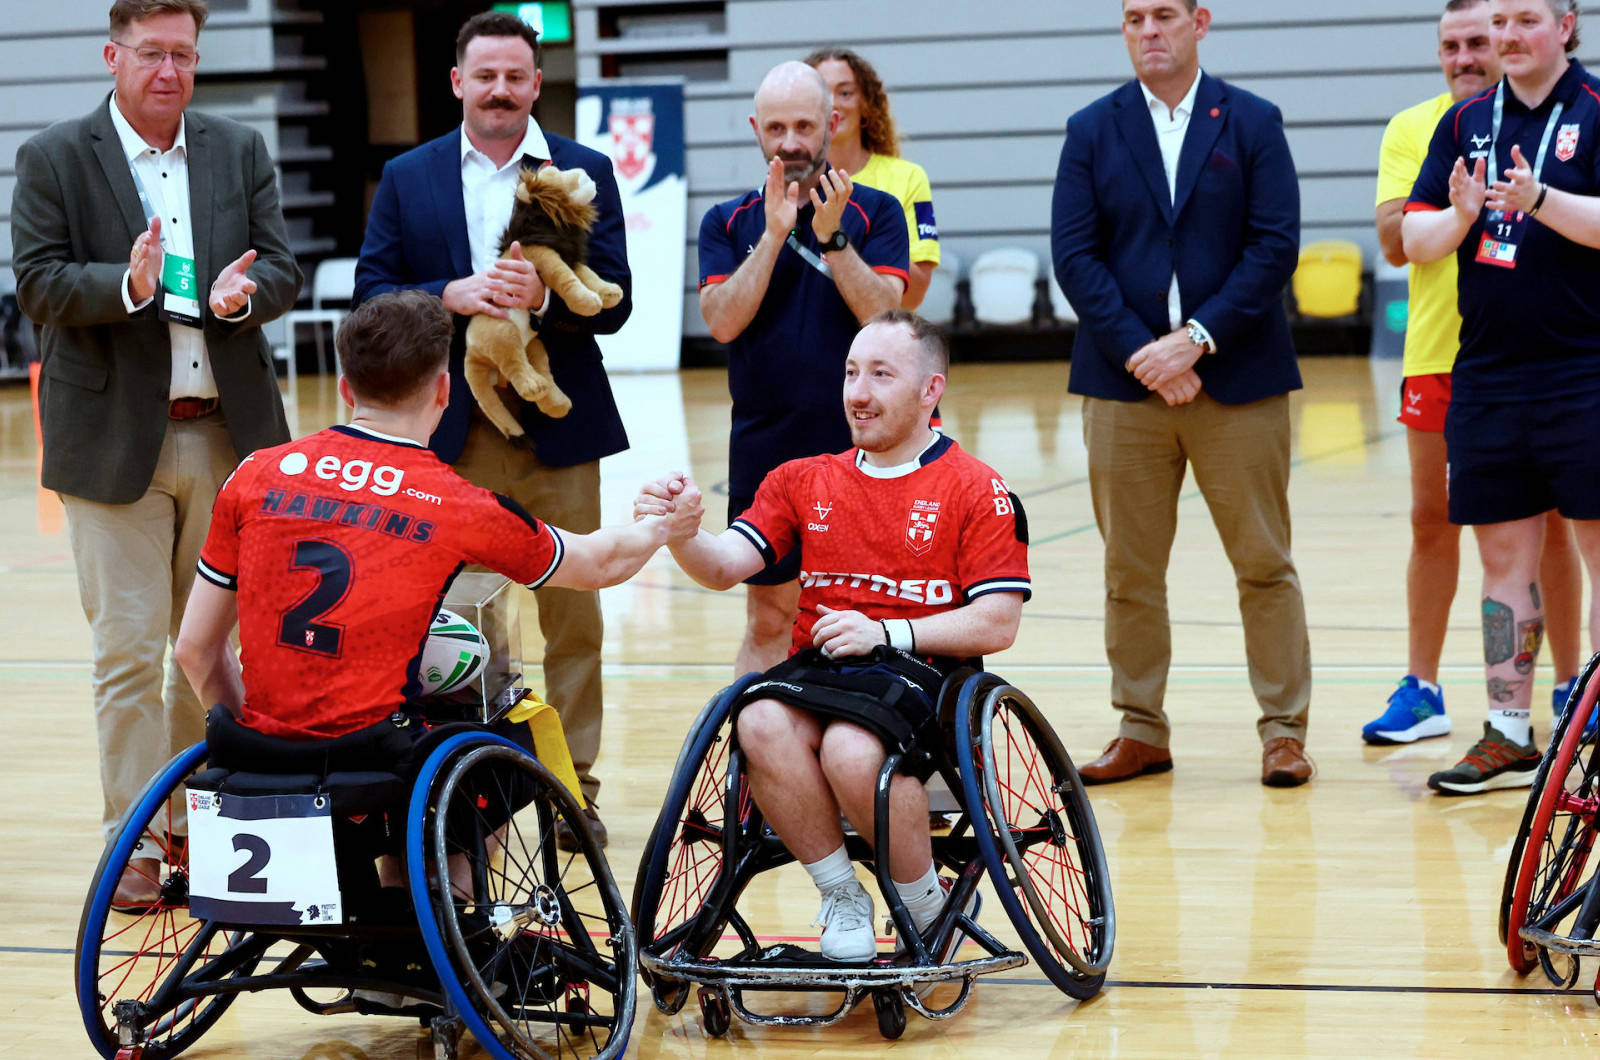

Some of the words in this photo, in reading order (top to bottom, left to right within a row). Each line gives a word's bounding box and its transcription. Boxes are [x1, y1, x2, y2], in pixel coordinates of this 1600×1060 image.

[1497, 223, 1512, 237] 11
[180, 277, 189, 290] 5
[259, 488, 437, 544] HAWKINS
[278, 538, 355, 658] 2
[228, 833, 271, 894] 2
